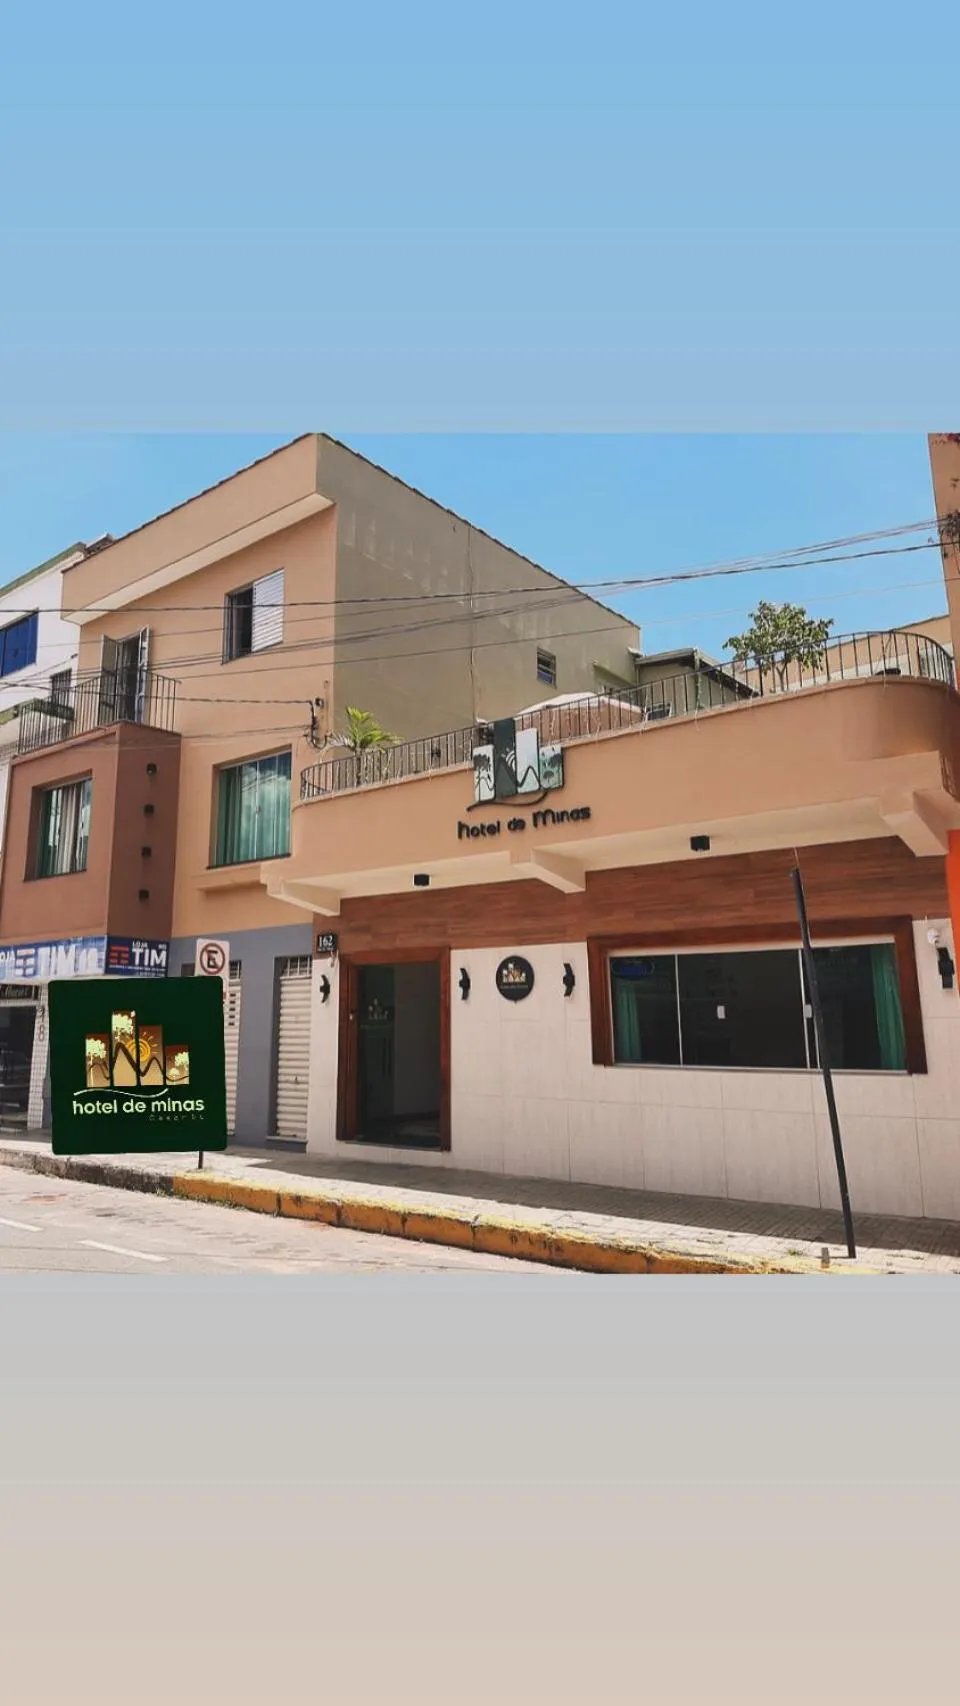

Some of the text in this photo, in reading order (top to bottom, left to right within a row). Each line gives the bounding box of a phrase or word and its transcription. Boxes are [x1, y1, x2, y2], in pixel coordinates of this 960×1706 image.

[507, 817, 526, 831] de
[319, 935, 333, 947] 162
[132, 948, 167, 968] TIM
[72, 1097, 205, 1115] hotel de minas
